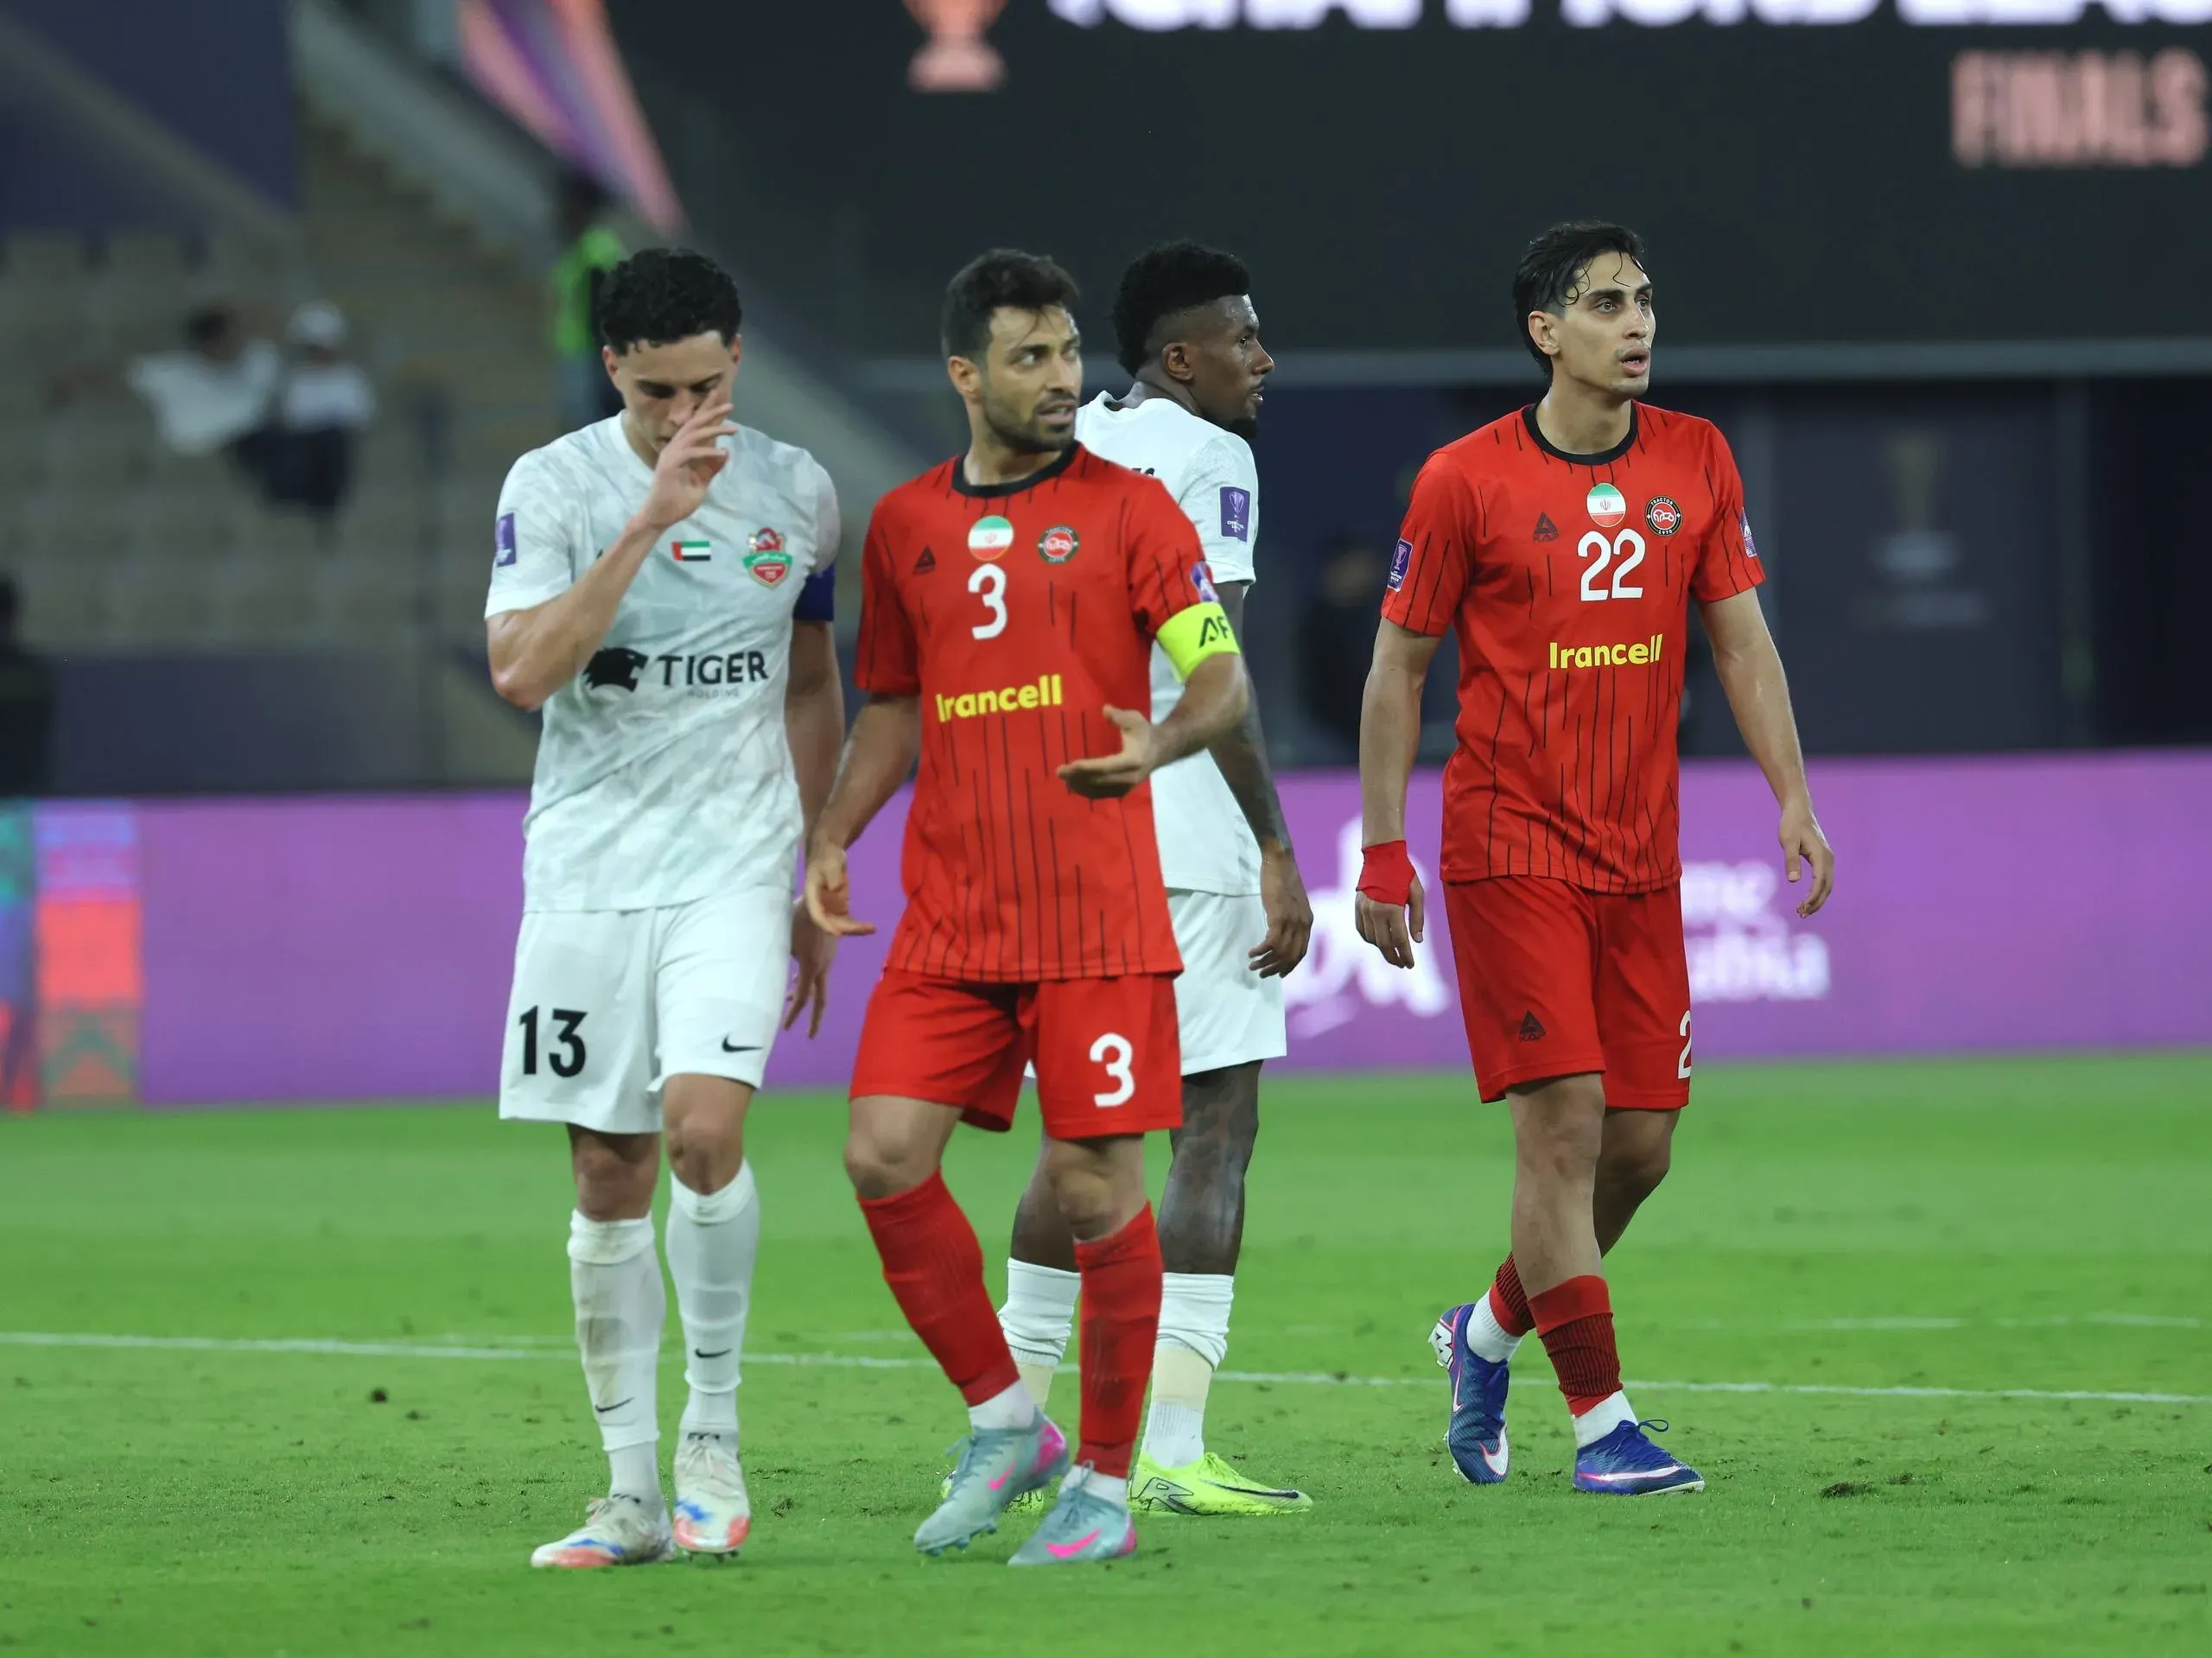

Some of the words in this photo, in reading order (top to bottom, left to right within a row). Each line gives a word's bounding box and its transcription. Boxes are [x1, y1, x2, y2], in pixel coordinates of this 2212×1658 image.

[1950, 48, 2209, 166] FINALS
[1650, 497, 1674, 505] TRACTOR
[1577, 528, 1645, 601] 22
[967, 563, 1008, 640] 3
[657, 651, 768, 686] TIGER
[1549, 633, 1663, 669] Irancell
[687, 688, 740, 699] HOLDING
[936, 674, 1062, 723] Irancell
[519, 1005, 588, 1077] 13
[1090, 1032, 1135, 1108] 3
